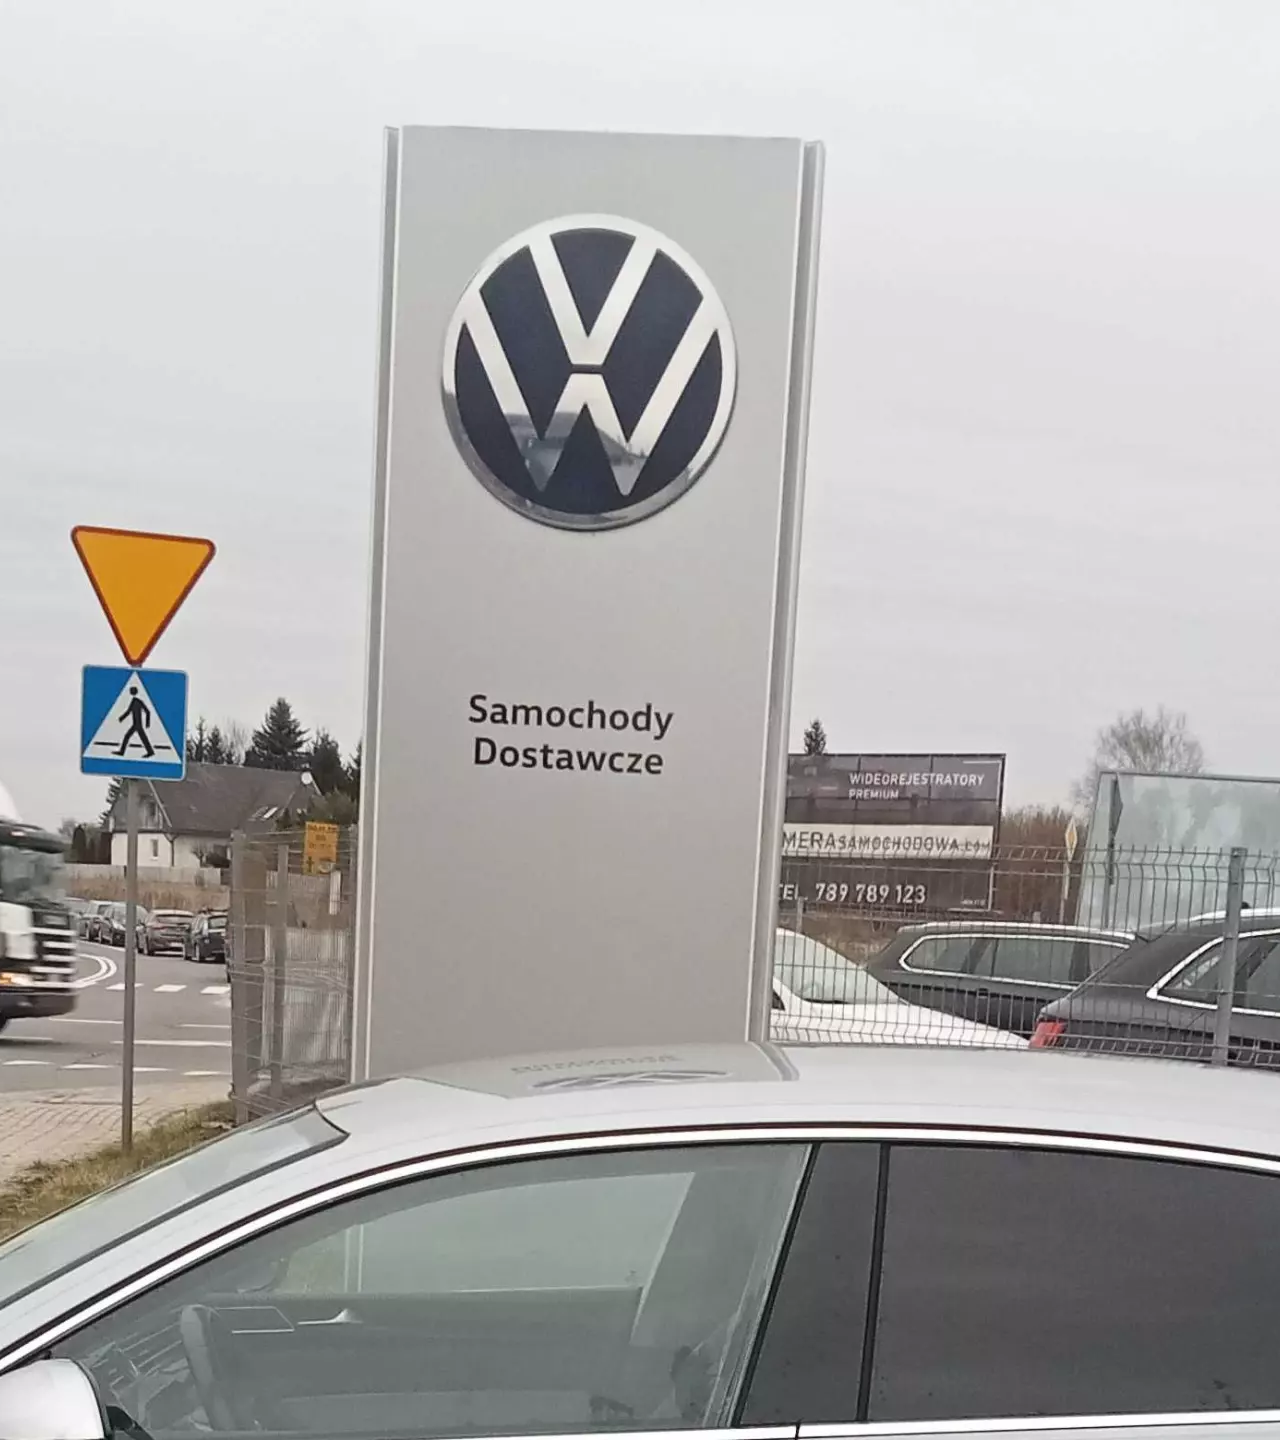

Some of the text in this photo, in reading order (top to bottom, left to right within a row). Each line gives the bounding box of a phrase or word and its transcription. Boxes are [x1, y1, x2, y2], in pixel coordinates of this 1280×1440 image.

[468, 694, 674, 740] Samochody
[474, 737, 664, 775] Dostawcze
[848, 773, 985, 787] WIDEOREJESTRATORY
[848, 789, 899, 799] PREMIUM
[815, 883, 848, 901] 789
[856, 884, 889, 903] 789
[895, 885, 926, 904] 123
